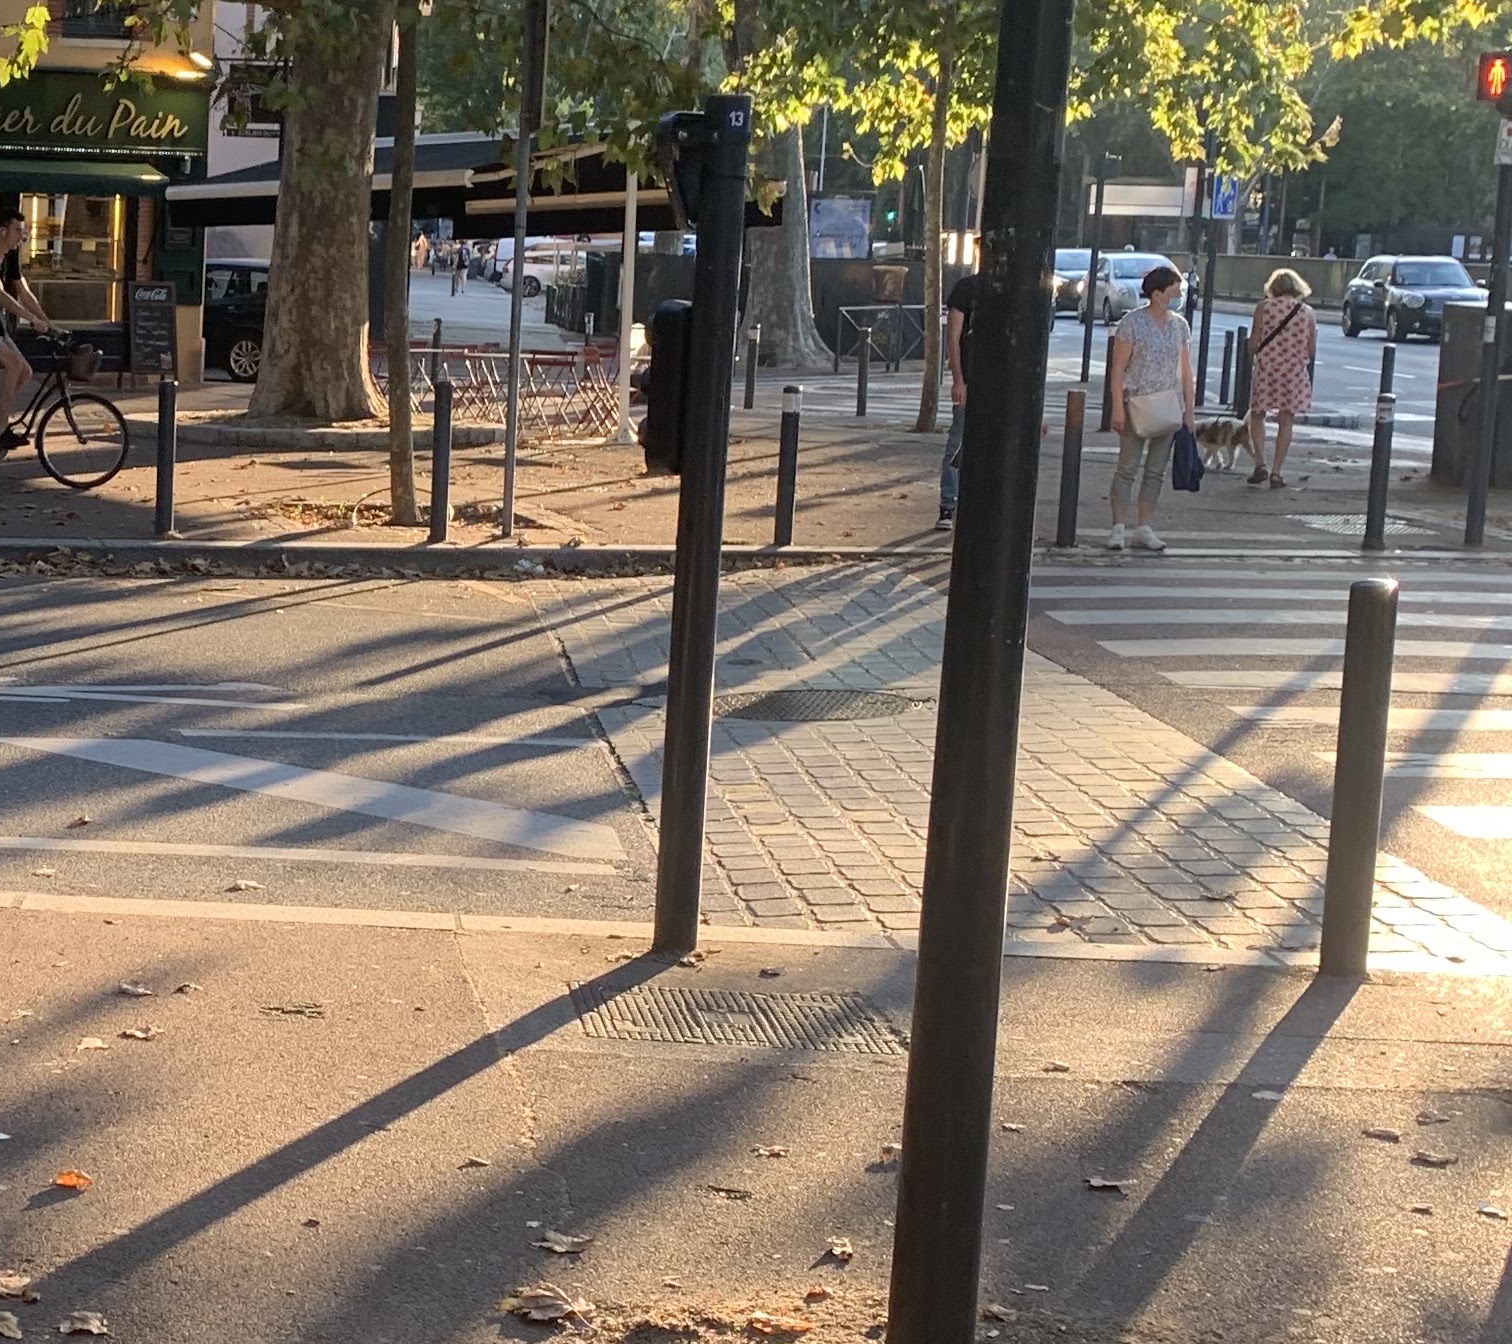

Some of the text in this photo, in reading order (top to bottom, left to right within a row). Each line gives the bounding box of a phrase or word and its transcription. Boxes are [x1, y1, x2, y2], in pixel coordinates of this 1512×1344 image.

[49, 92, 103, 136] du
[106, 98, 189, 139] Pain
[729, 110, 744, 127] 13
